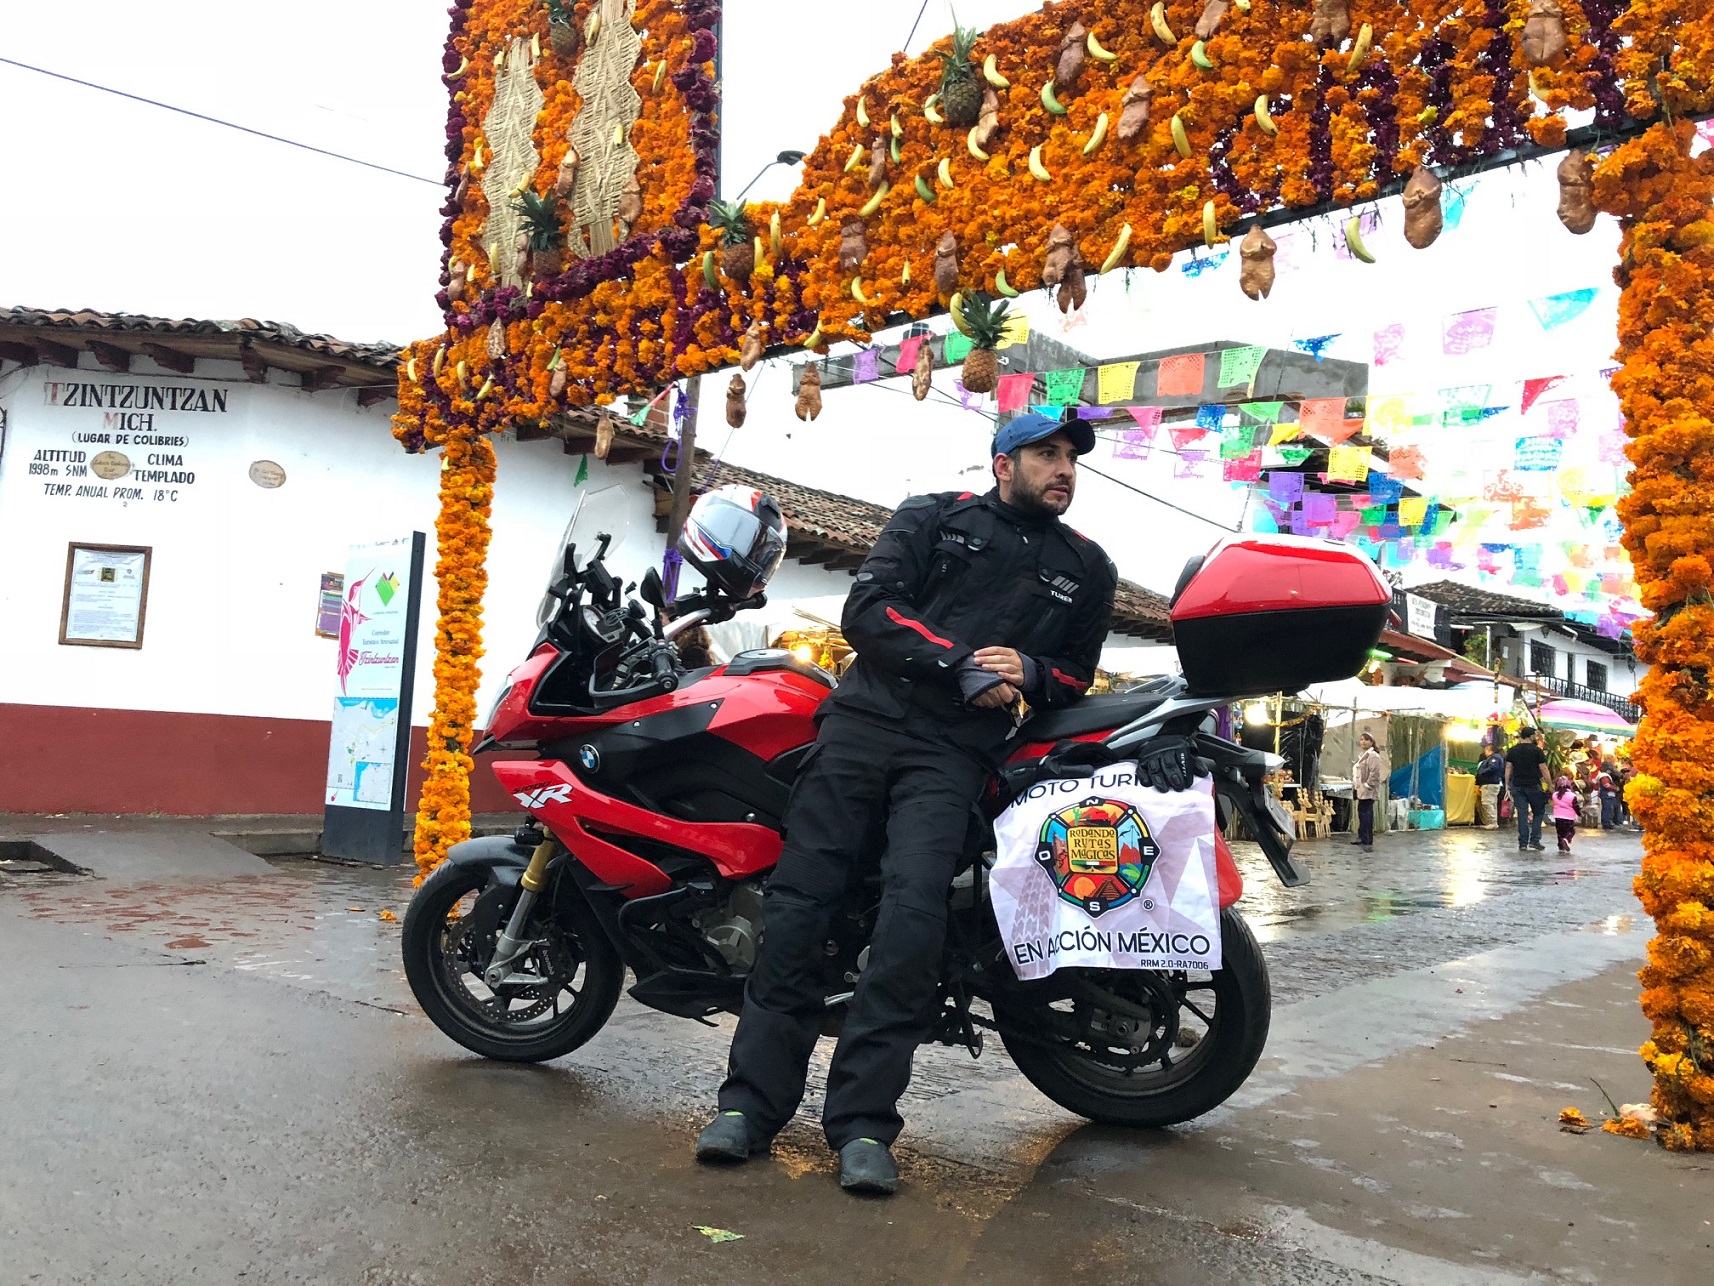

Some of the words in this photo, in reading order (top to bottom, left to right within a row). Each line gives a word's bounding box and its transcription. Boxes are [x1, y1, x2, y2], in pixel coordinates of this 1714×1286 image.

[44, 382, 228, 413] TZINTZUNTZAN
[103, 411, 157, 432] MICH.
[72, 430, 111, 444] (LUGAR
[115, 434, 130, 445] DE
[133, 435, 190, 448] COLIBRIES)
[33, 449, 87, 463] ALTITUD
[147, 453, 183, 467] CLIMA
[65, 464, 88, 477] SNM
[134, 469, 195, 484] TEMPLADO
[44, 483, 73, 496] TEMP.
[75, 485, 108, 498] ANUAL
[113, 486, 144, 500] PROM.
[513, 783, 573, 809] XR
[1010, 779, 1080, 808] MOTO
[1085, 798, 1099, 806] N
[1143, 845, 1155, 856] E
[1089, 901, 1101, 912] S
[1013, 940, 1044, 965] EN
[1047, 925, 1112, 958] ACCIÓN
[1117, 926, 1211, 956] MÉXICO
[1140, 959, 1160, 968] RRM
